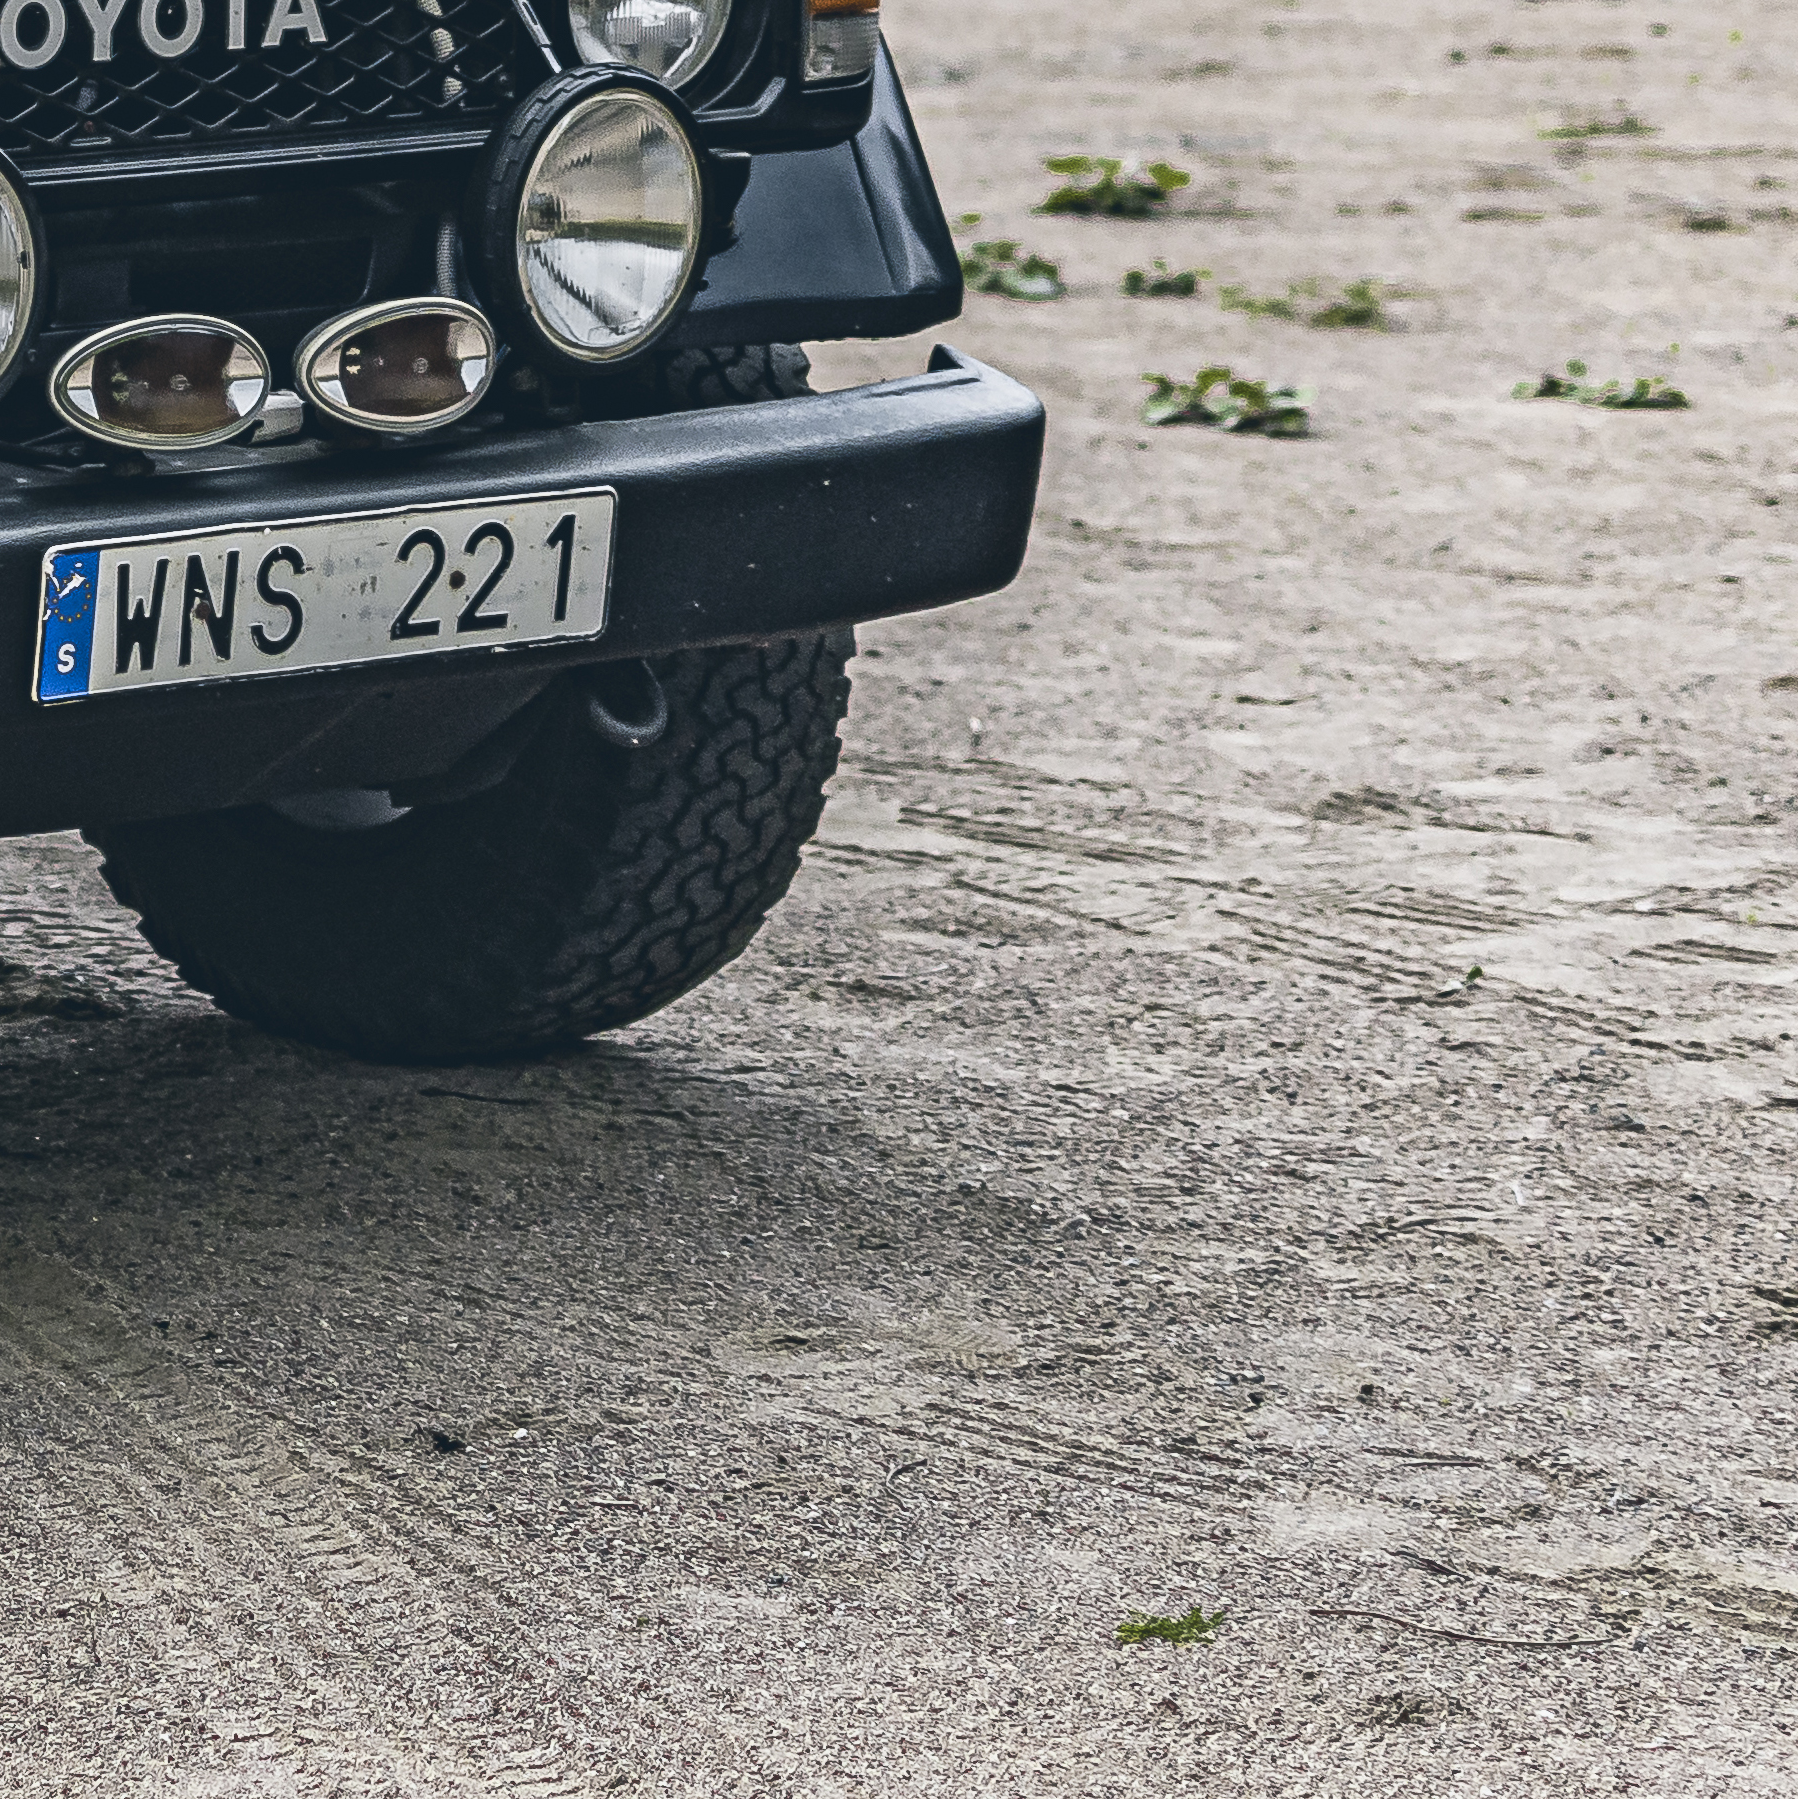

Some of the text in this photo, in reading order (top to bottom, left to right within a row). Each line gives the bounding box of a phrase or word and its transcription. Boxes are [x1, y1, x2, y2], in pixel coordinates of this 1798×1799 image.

[114, 512, 577, 675] WNS 221
[56, 644, 76, 675] S
